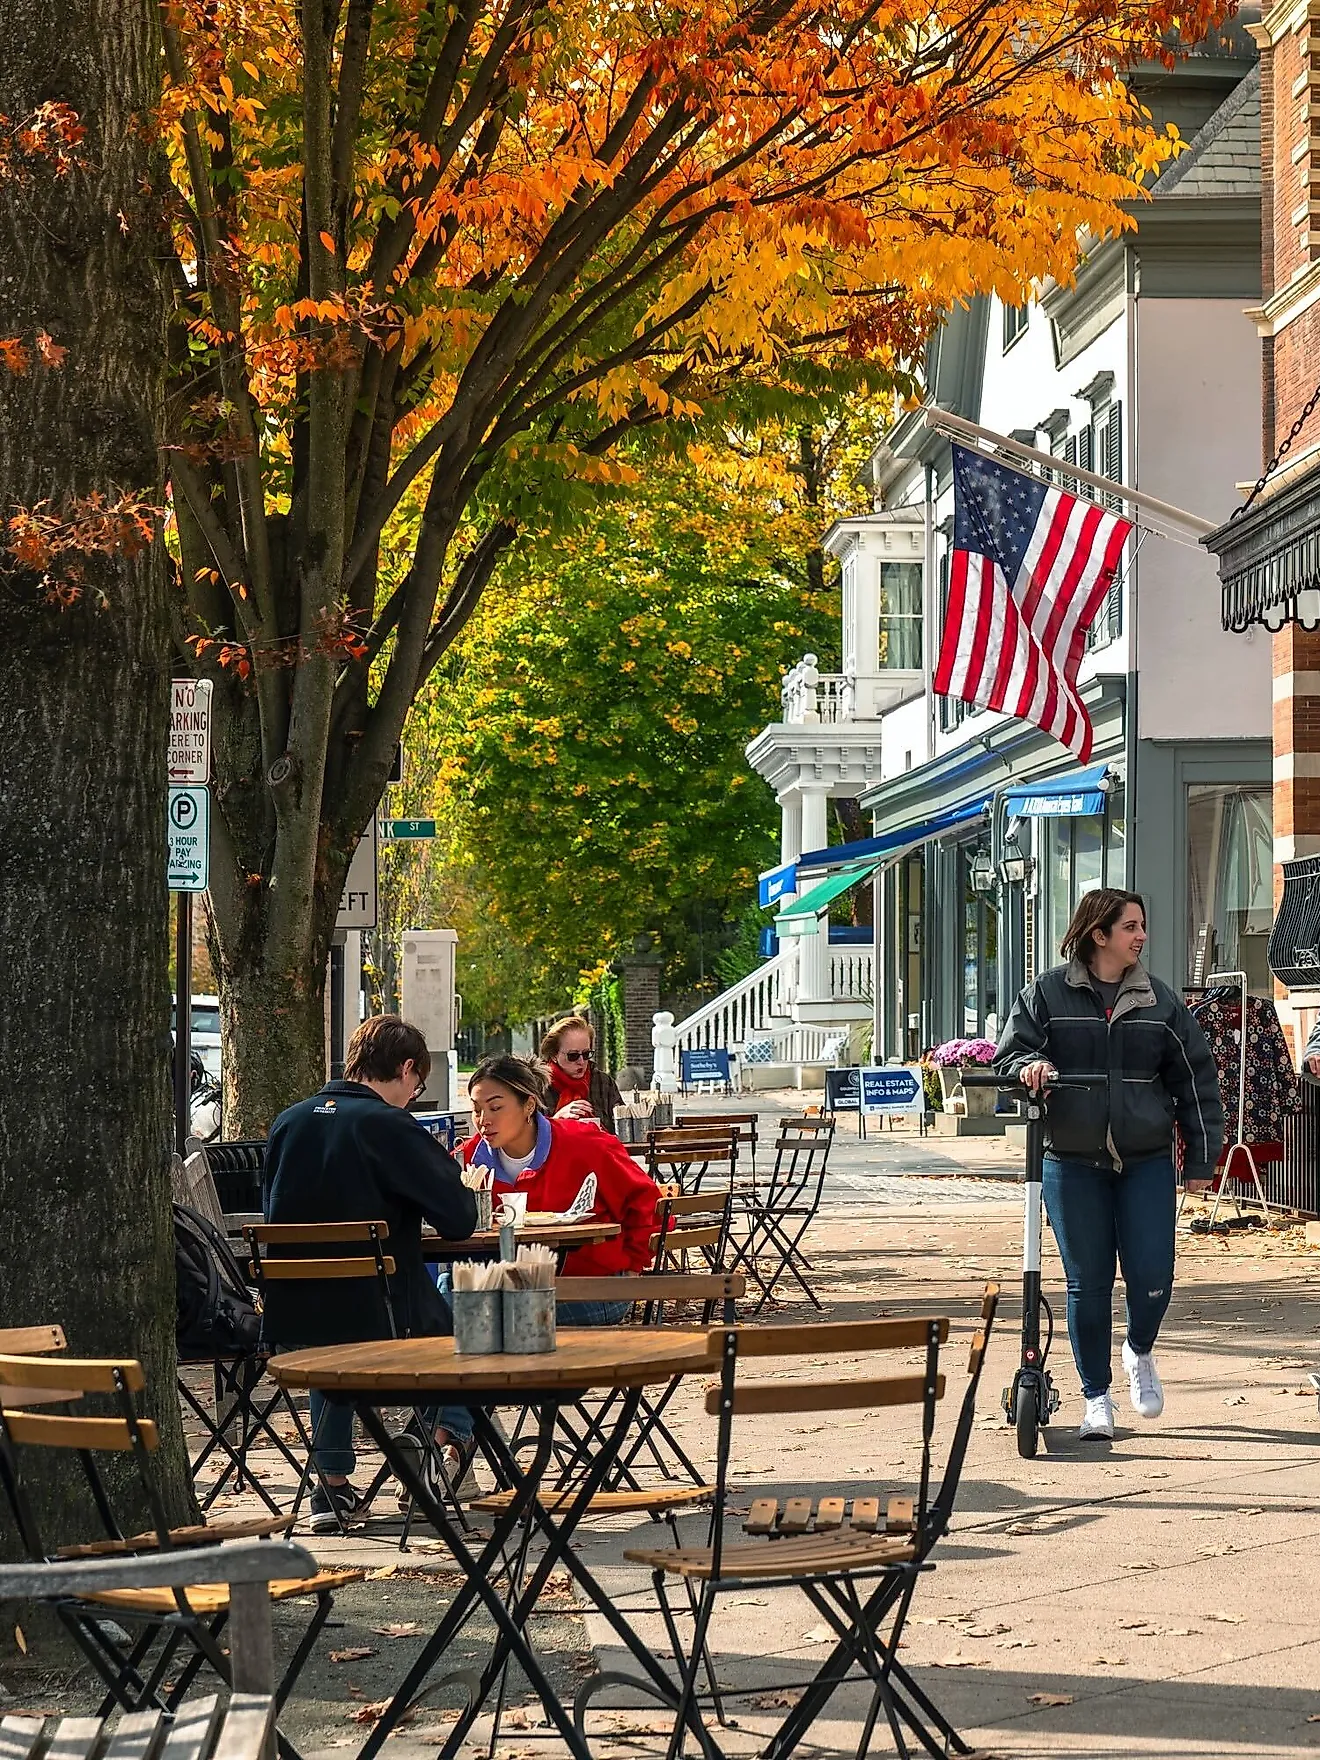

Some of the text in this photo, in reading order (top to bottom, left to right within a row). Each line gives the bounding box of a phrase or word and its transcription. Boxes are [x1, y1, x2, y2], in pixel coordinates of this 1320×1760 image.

[175, 688, 195, 708] NO
[170, 711, 207, 731] ARKING
[171, 733, 205, 747] ERE TO
[166, 750, 203, 764] CORNER
[379, 822, 420, 838] NK ST
[169, 836, 198, 847] 3 HOUR
[175, 848, 192, 858] PAY
[338, 892, 369, 911] EFT
[864, 1079, 914, 1088] REAL ESTATE
[866, 1088, 885, 1096] INFO
[885, 1087, 892, 1095] &
[892, 1087, 914, 1096] MAPS
